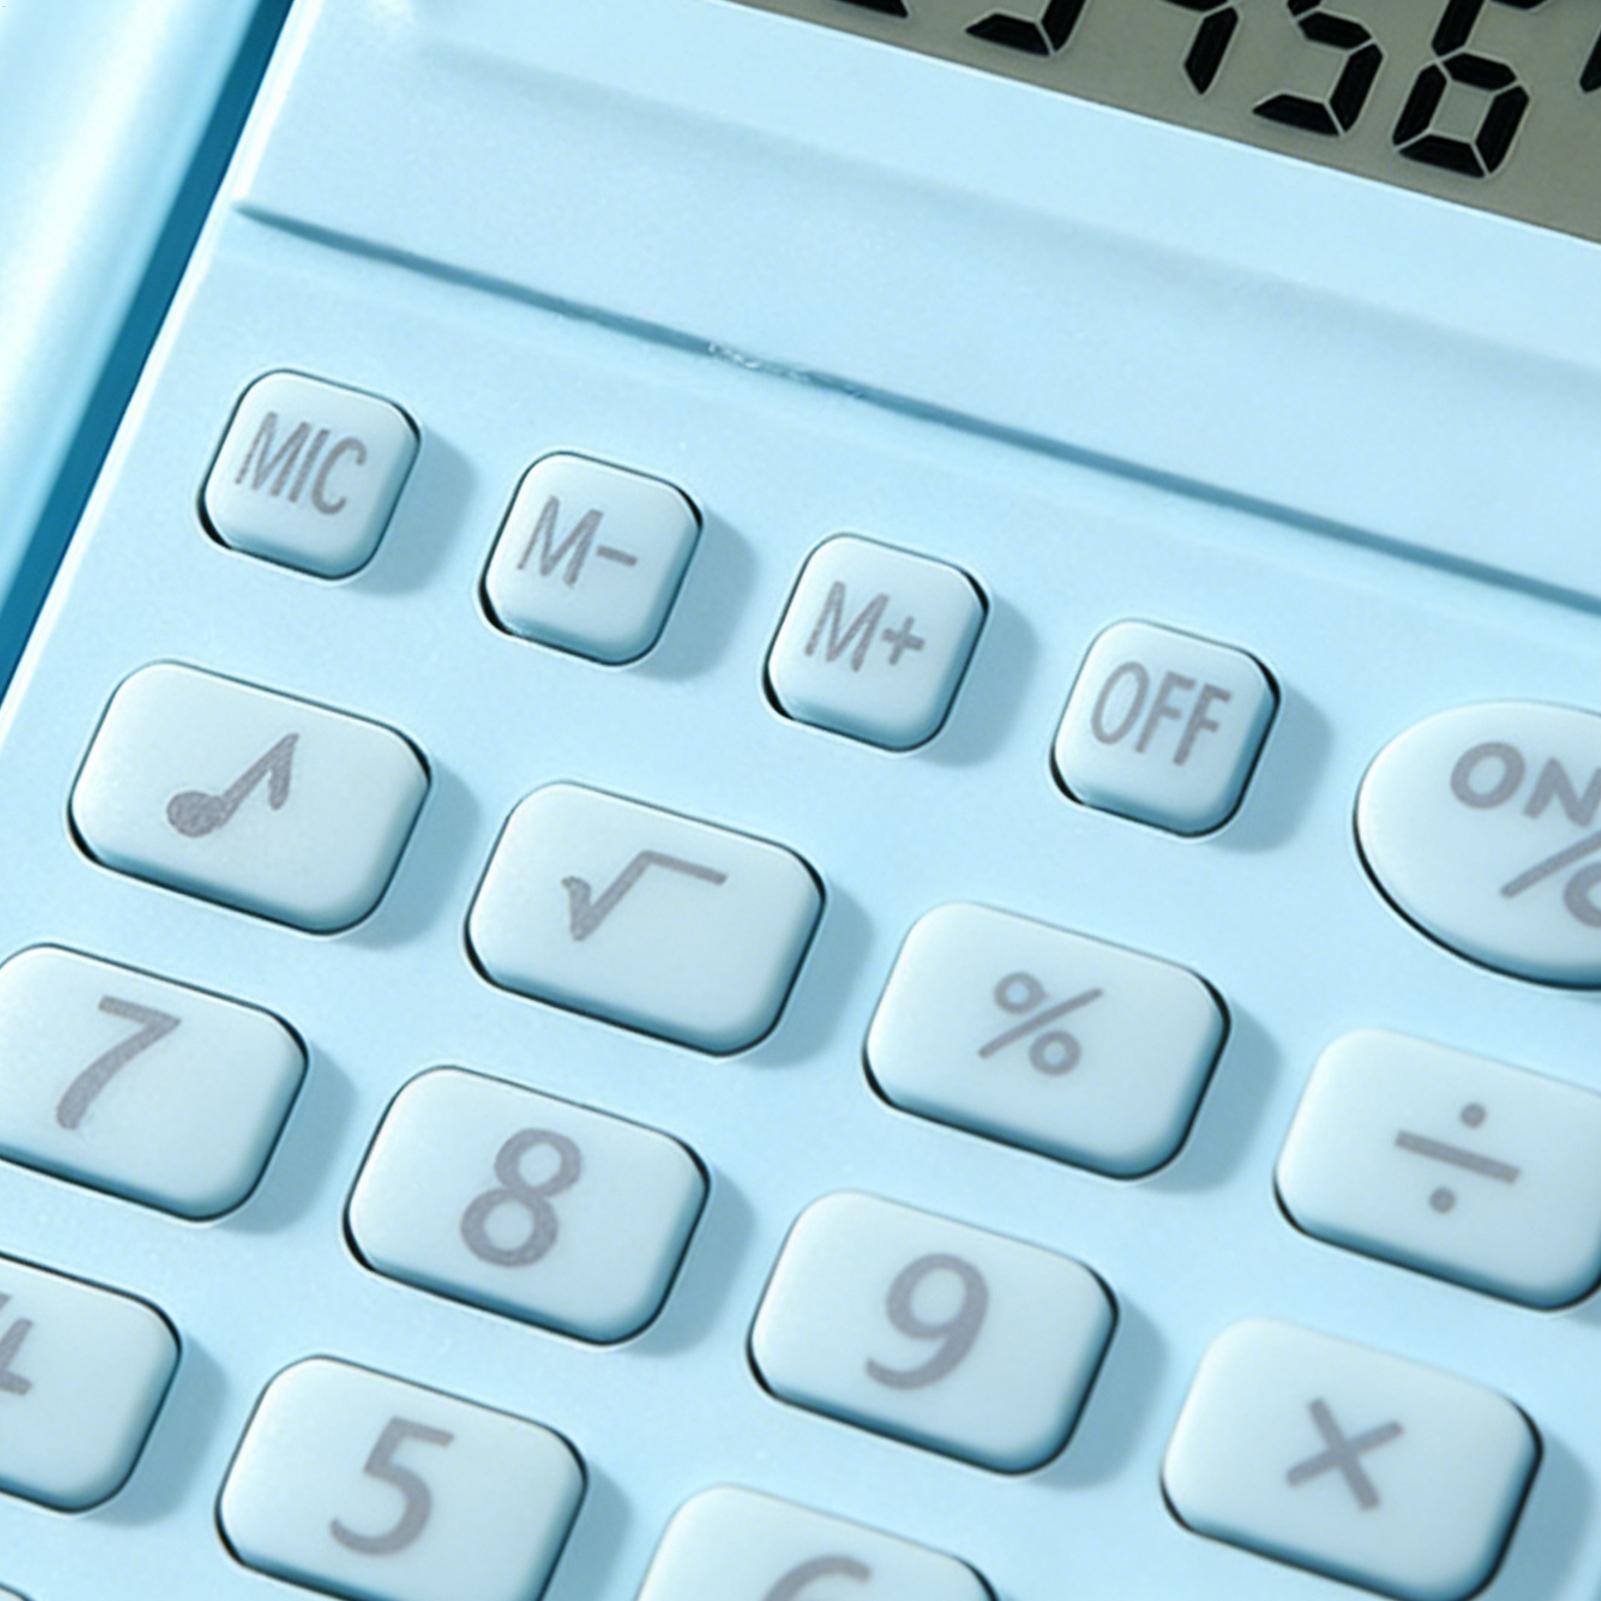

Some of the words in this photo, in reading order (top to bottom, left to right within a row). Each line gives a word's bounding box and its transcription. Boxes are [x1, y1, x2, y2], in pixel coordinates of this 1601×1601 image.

[234, 411, 367, 516] MIC
[804, 580, 925, 673] M+
[1090, 661, 1232, 767] OFF
[1450, 741, 1601, 828] ON
[55, 994, 182, 1132] 7
[978, 971, 1103, 1077] %
[459, 1127, 583, 1270] 8
[865, 1252, 989, 1391] 9
[329, 1415, 455, 1557] 5
